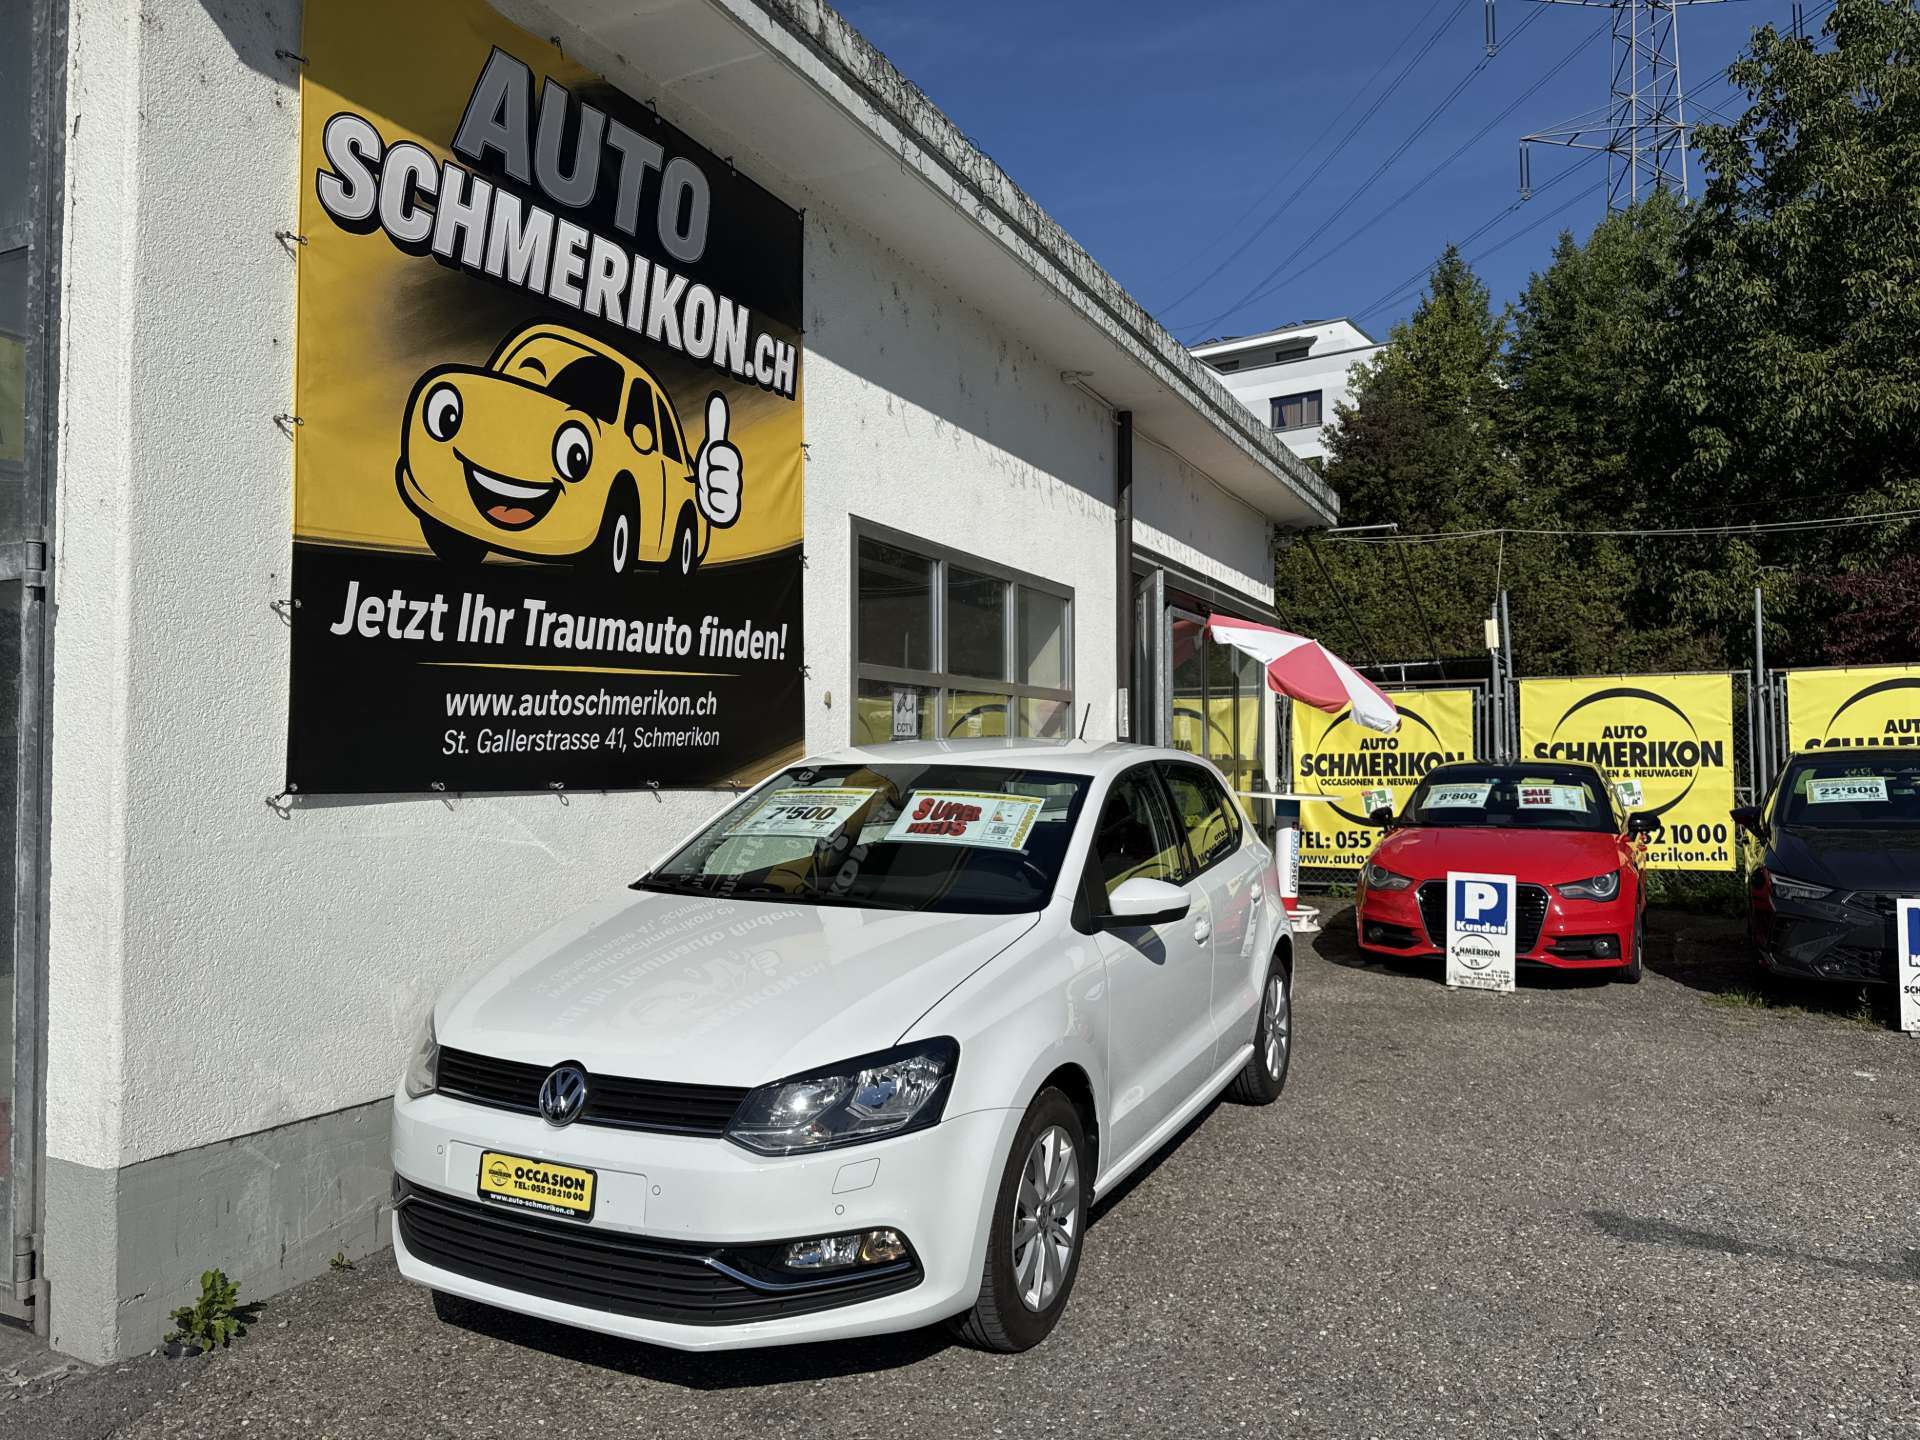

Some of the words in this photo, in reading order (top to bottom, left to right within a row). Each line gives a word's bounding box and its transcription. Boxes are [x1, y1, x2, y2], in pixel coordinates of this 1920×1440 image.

[451, 46, 711, 264] AUTO
[317, 113, 797, 397] SCHMERIKON.CH
[329, 580, 448, 642] Jetzt
[456, 592, 515, 646] Ihr
[522, 598, 692, 656] Traumauto
[700, 615, 788, 661] finden!
[445, 688, 718, 718] www.autoschmerikon.ch
[896, 722, 913, 733] CCTV
[1602, 725, 1647, 739] AUTO
[442, 730, 471, 756] St.
[477, 729, 600, 754] Gallerstrasse
[604, 729, 628, 754] 41,
[633, 725, 720, 748] Schmerikon
[1360, 738, 1399, 751] AUTO
[1622, 769, 1631, 777] &
[1634, 768, 1693, 778] NEUWAGEN
[1320, 777, 1374, 787] OCCASIONEN
[1376, 777, 1384, 787] &
[1819, 786, 1880, 795] 22'800
[1522, 789, 1552, 797] SALE
[1522, 797, 1553, 805] SALE
[766, 806, 838, 821] 7'500
[912, 798, 982, 822] SUPER
[905, 820, 968, 837] PREIS
[1671, 824, 1693, 844] 10
[1697, 823, 1727, 844] 00
[1335, 831, 1372, 849] 055
[1290, 831, 1299, 894] LeaseForce
[1464, 882, 1499, 920] P
[1456, 920, 1507, 935] Kunden
[514, 1167, 586, 1192] OCCASION
[514, 1180, 530, 1191] TEL:
[531, 1184, 546, 1194] 055
[490, 1193, 575, 1216] www.auto-schmerikon.ch
